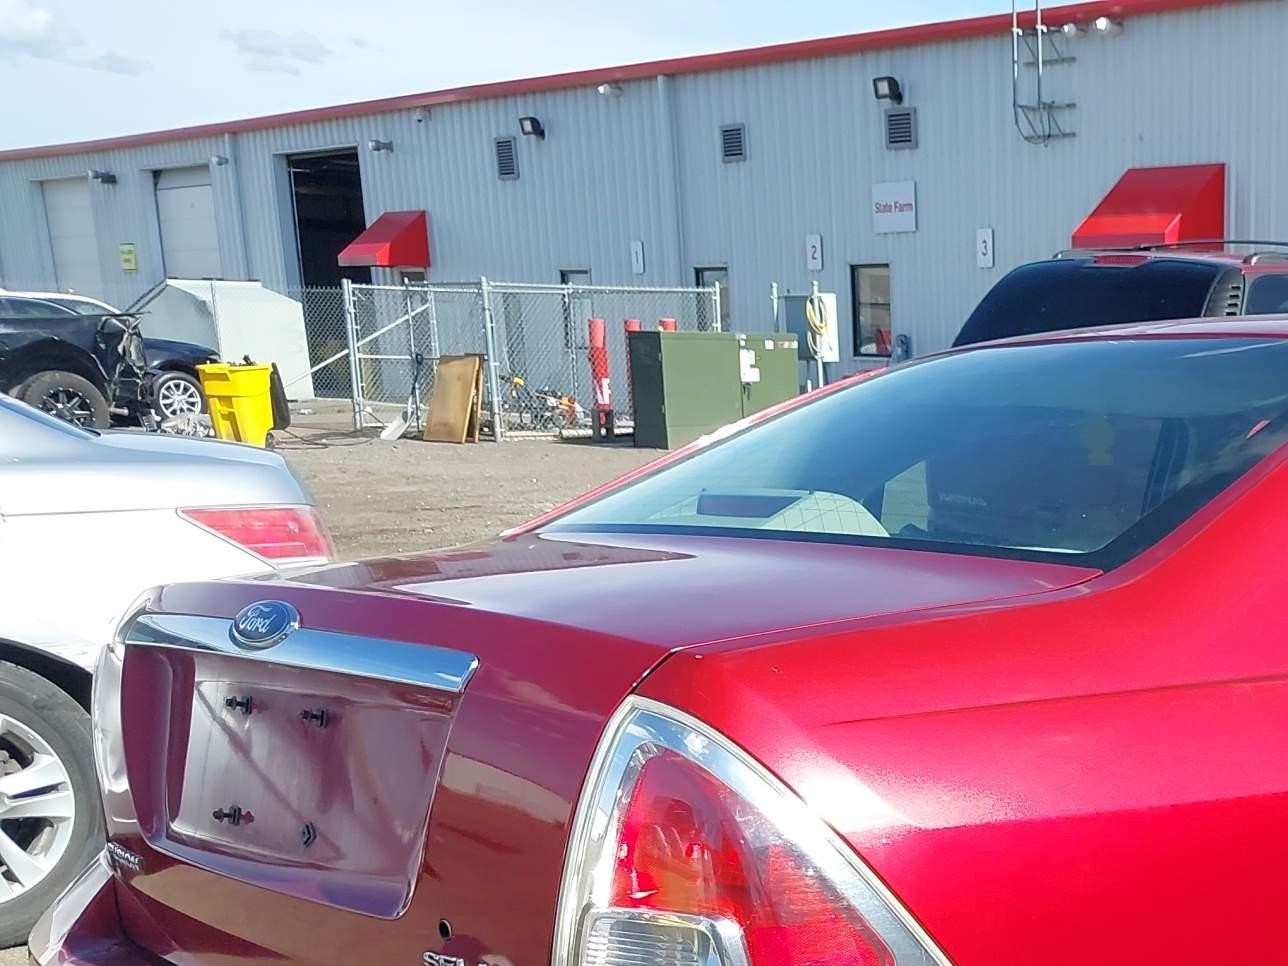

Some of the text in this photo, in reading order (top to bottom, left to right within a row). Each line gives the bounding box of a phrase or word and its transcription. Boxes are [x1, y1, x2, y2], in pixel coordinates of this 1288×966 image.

[811, 245, 817, 261] 2
[982, 240, 988, 257] 3
[238, 605, 277, 633] Ford
